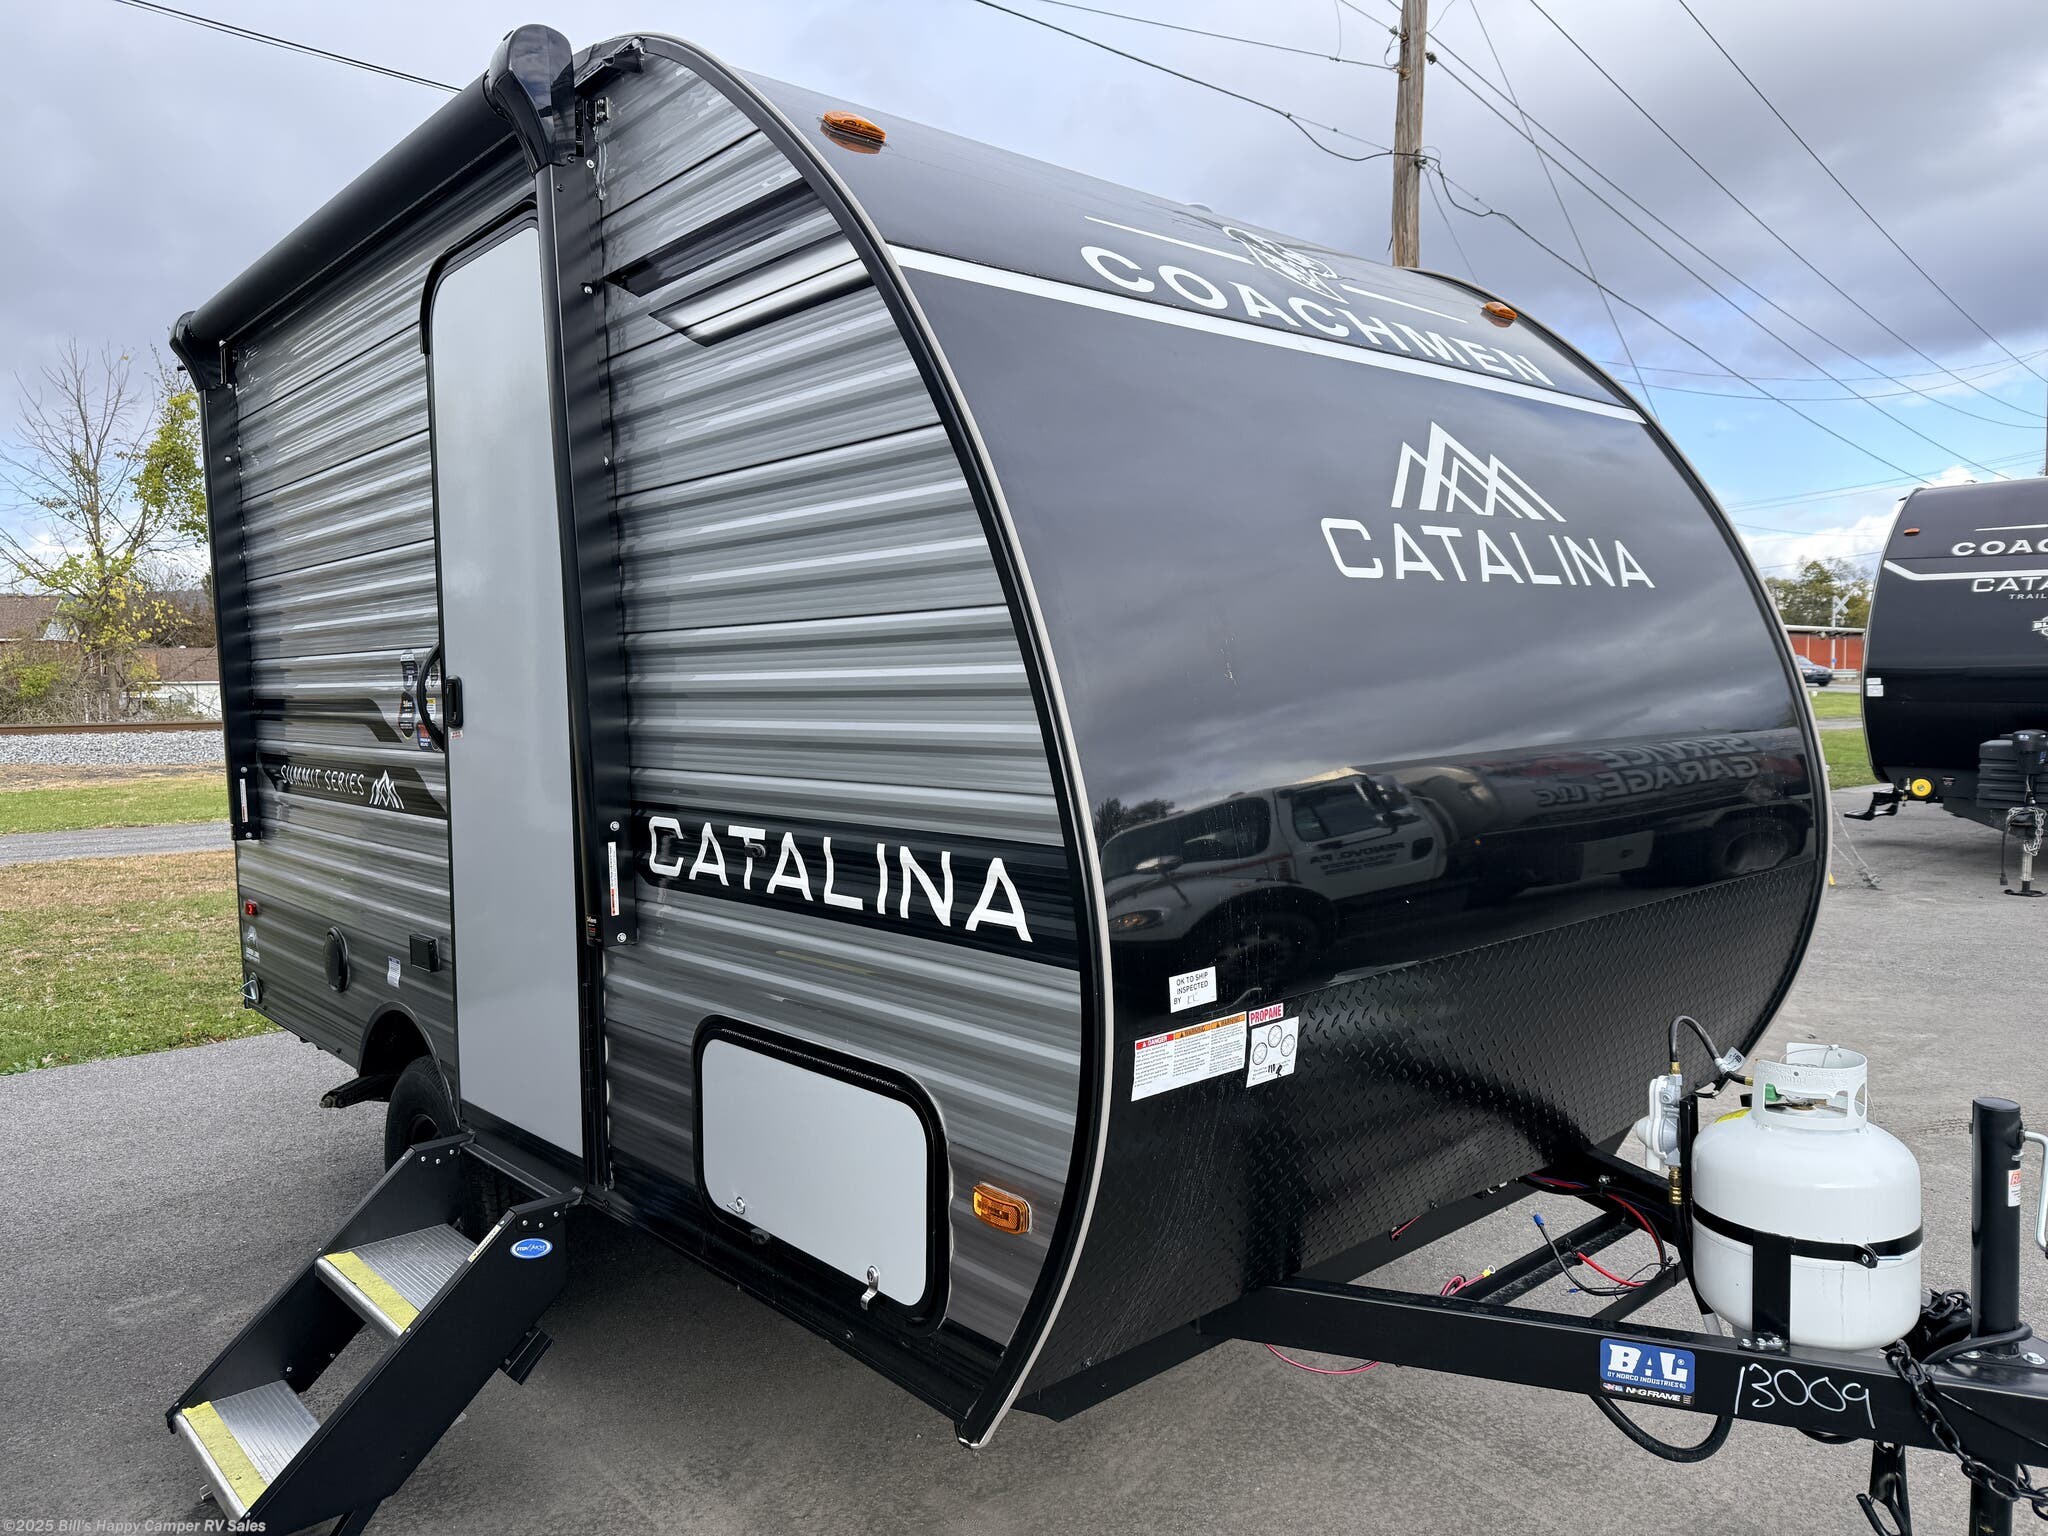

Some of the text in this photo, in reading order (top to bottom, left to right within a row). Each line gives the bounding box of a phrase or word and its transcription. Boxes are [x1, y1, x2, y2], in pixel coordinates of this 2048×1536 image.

[1080, 246, 1556, 386] COACHMEN
[1321, 518, 1655, 588] CATALINA
[280, 764, 365, 796] SUMMIT SERIES
[649, 816, 1033, 943] CATALINA
[1176, 971, 1209, 986] OK TO SHIP
[1176, 980, 1208, 995] INSPECTED
[1173, 996, 1182, 1005] BY
[1250, 1005, 1282, 1025] PROPANE
[1148, 1035, 1168, 1047] DANGER
[1608, 1344, 1688, 1382] BAL
[1616, 1372, 1639, 1381] NORCO
[1640, 1376, 1679, 1389] INDUSTRIES
[1647, 1390, 1681, 1402] FRAME
[1734, 1362, 1876, 1430] 13009
